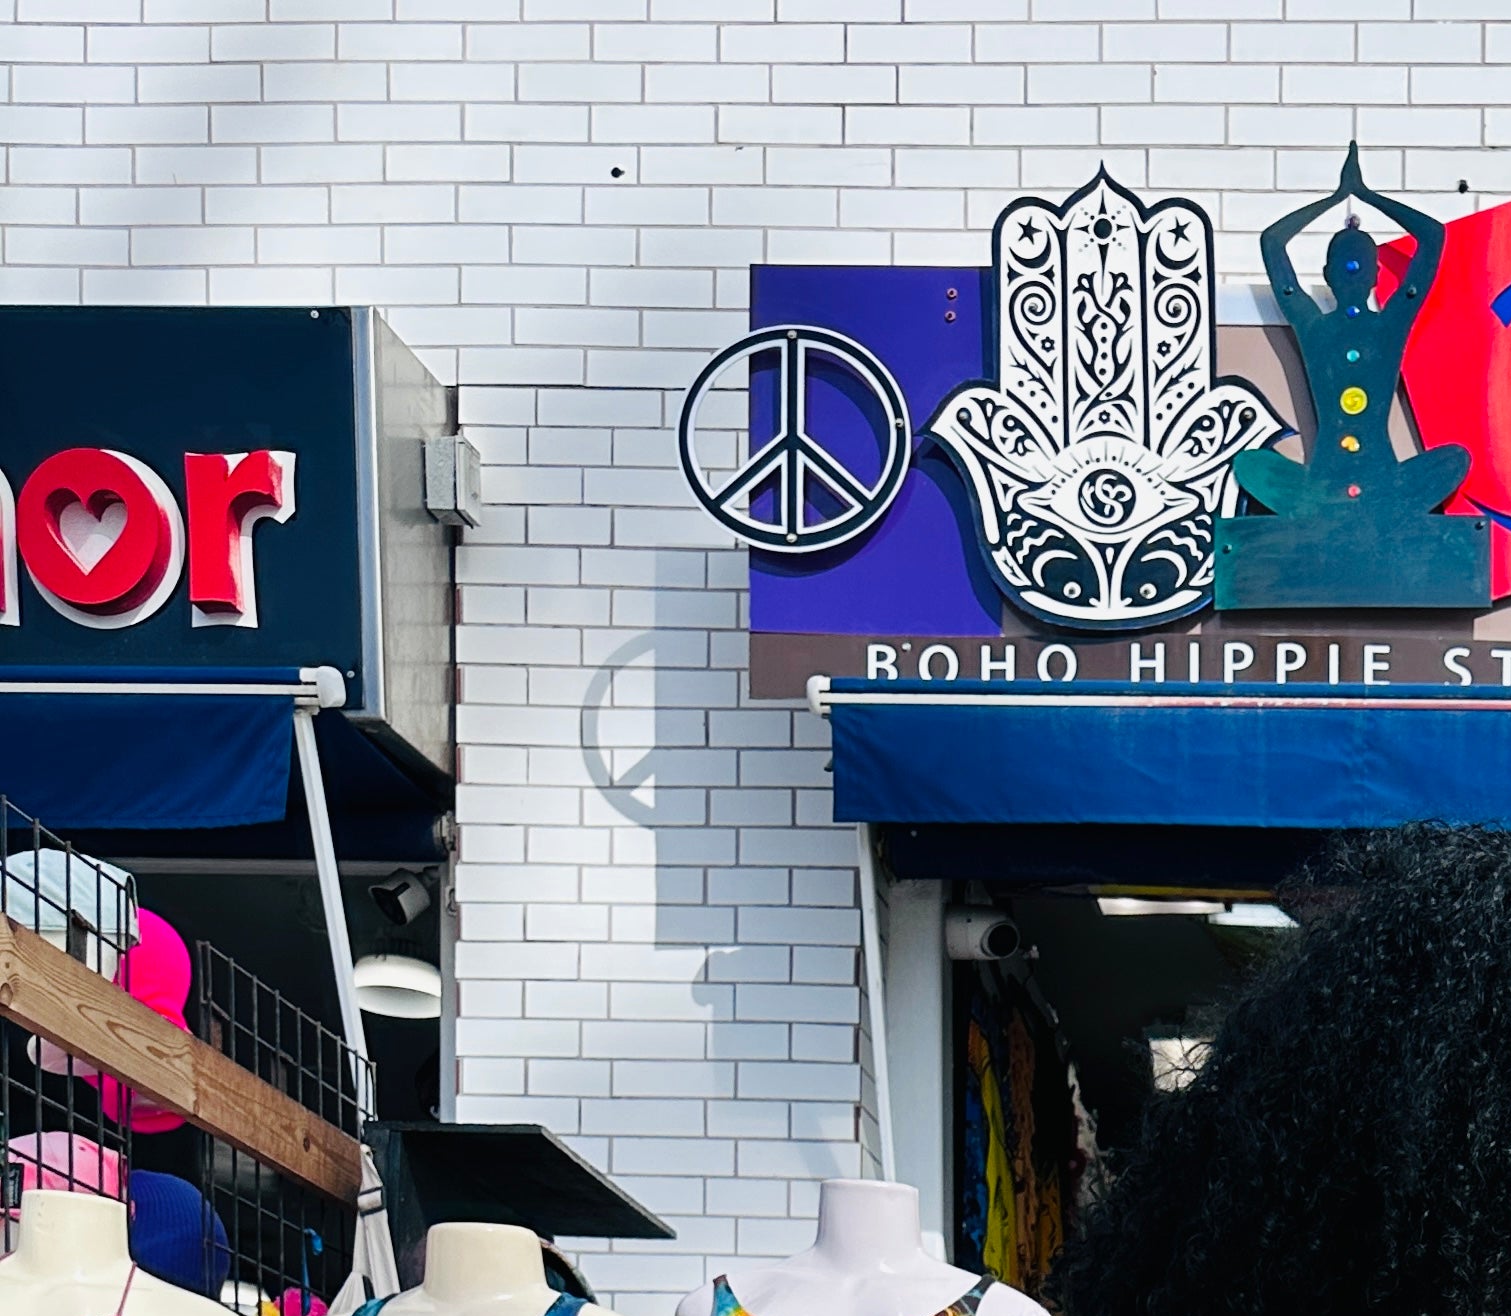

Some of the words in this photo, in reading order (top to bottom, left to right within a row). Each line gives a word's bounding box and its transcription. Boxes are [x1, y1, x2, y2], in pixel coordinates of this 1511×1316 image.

[0, 447, 297, 629] or
[866, 642, 1078, 681] BOHO
[1129, 641, 1392, 686] HIPPIE
